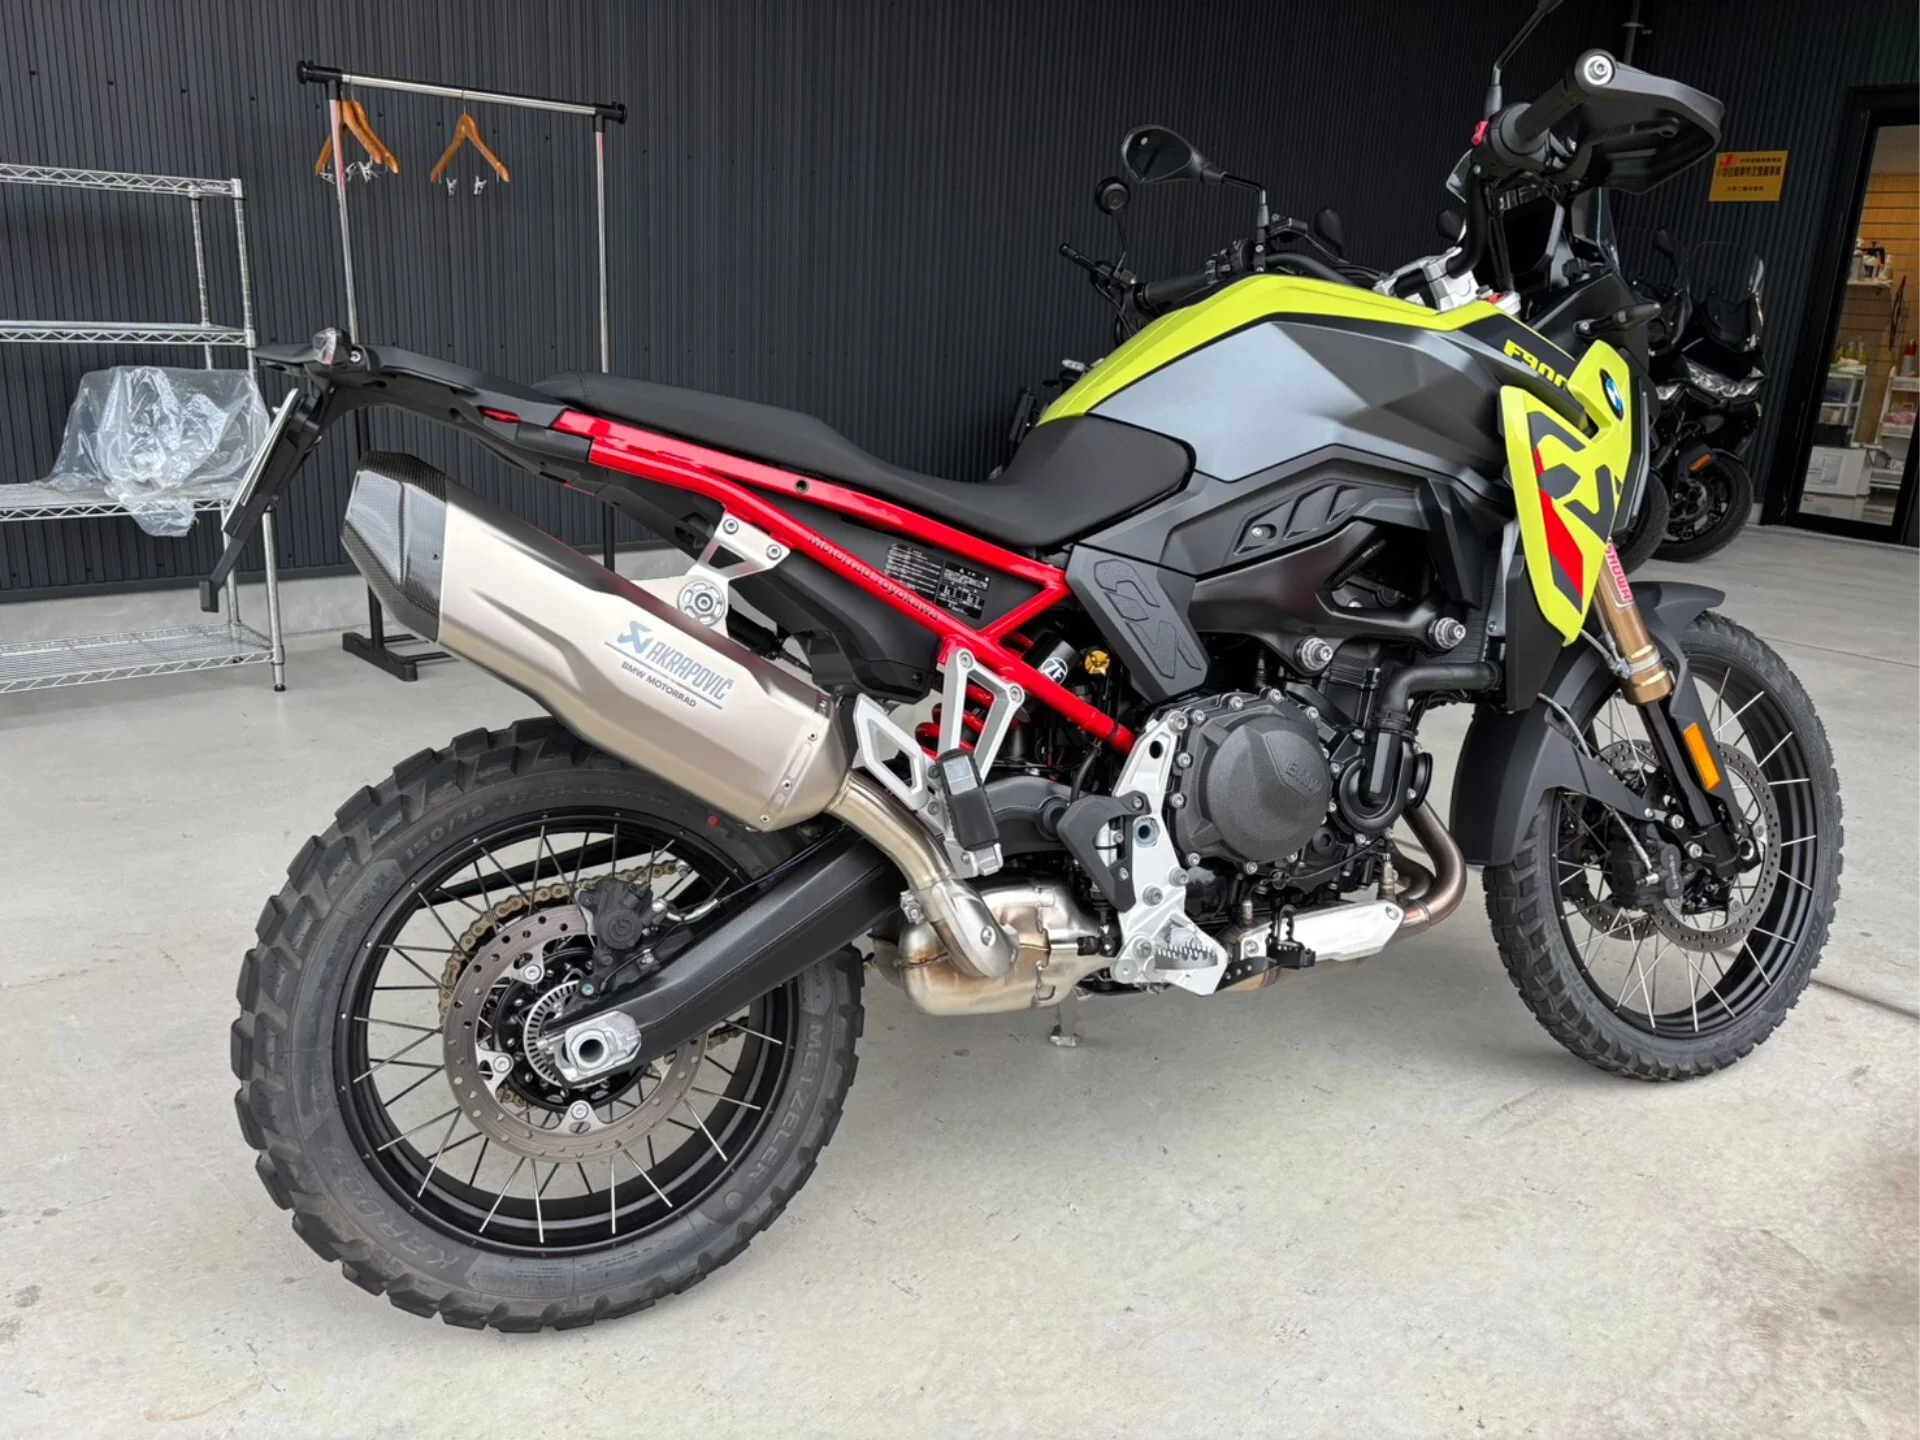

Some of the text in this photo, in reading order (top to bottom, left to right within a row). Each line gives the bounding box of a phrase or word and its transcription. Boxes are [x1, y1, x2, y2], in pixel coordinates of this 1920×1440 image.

[1605, 544, 1633, 601] SHOWA
[620, 661, 697, 708] BMW MOTORRAD
[1040, 658, 1067, 683] ZF
[747, 1020, 824, 1187] METZELER
